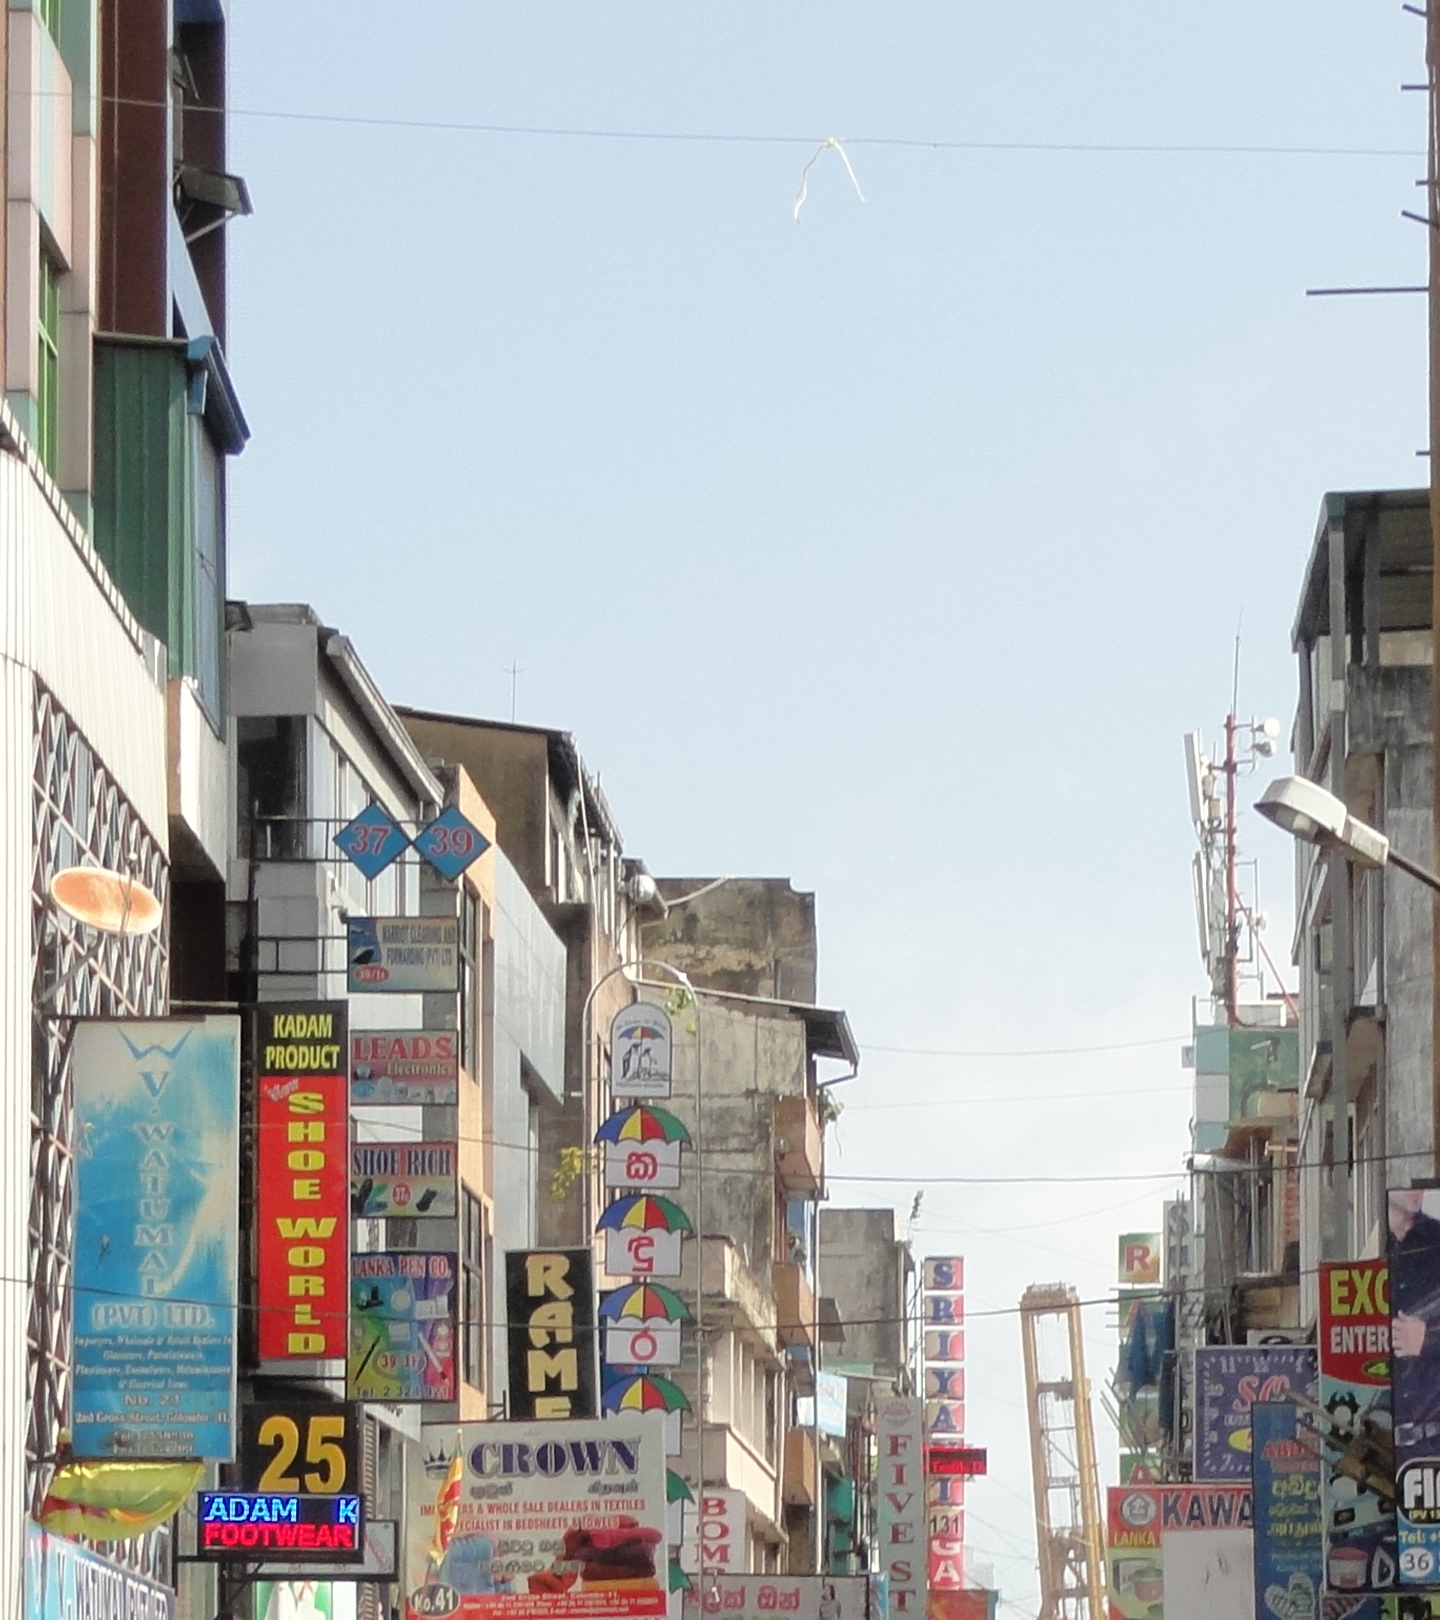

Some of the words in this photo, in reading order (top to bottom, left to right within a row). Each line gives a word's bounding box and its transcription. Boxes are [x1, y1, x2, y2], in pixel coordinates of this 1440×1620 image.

[348, 823, 392, 856] 37
[429, 826, 476, 857] 39
[273, 1014, 333, 1039] KADAM
[265, 1045, 340, 1070] PRODUCT
[387, 1063, 453, 1075] Electronics
[288, 1091, 326, 1200] SHOE
[353, 1149, 401, 1177] SHOE
[407, 1149, 451, 1177] RICH
[351, 1258, 393, 1277] LANKA
[276, 1216, 338, 1354] WORLD
[92, 1301, 157, 1330] (PVT)
[257, 1415, 347, 1493] 25
[468, 1436, 642, 1479] CROWN
[886, 1433, 914, 1545] FIVE
[487, 1499, 519, 1514] WHOLE
[522, 1499, 544, 1513] SALE
[547, 1499, 589, 1513] DEALERS
[591, 1499, 601, 1512] IN
[604, 1498, 646, 1512] TEXTILES
[204, 1523, 353, 1548] FOOTWEAR
[503, 1518, 513, 1531] IN
[928, 1514, 960, 1535] 131
[1113, 1531, 1156, 1547] LANKA
[1404, 1552, 1430, 1572] 36
[414, 1587, 455, 1613] No.41
